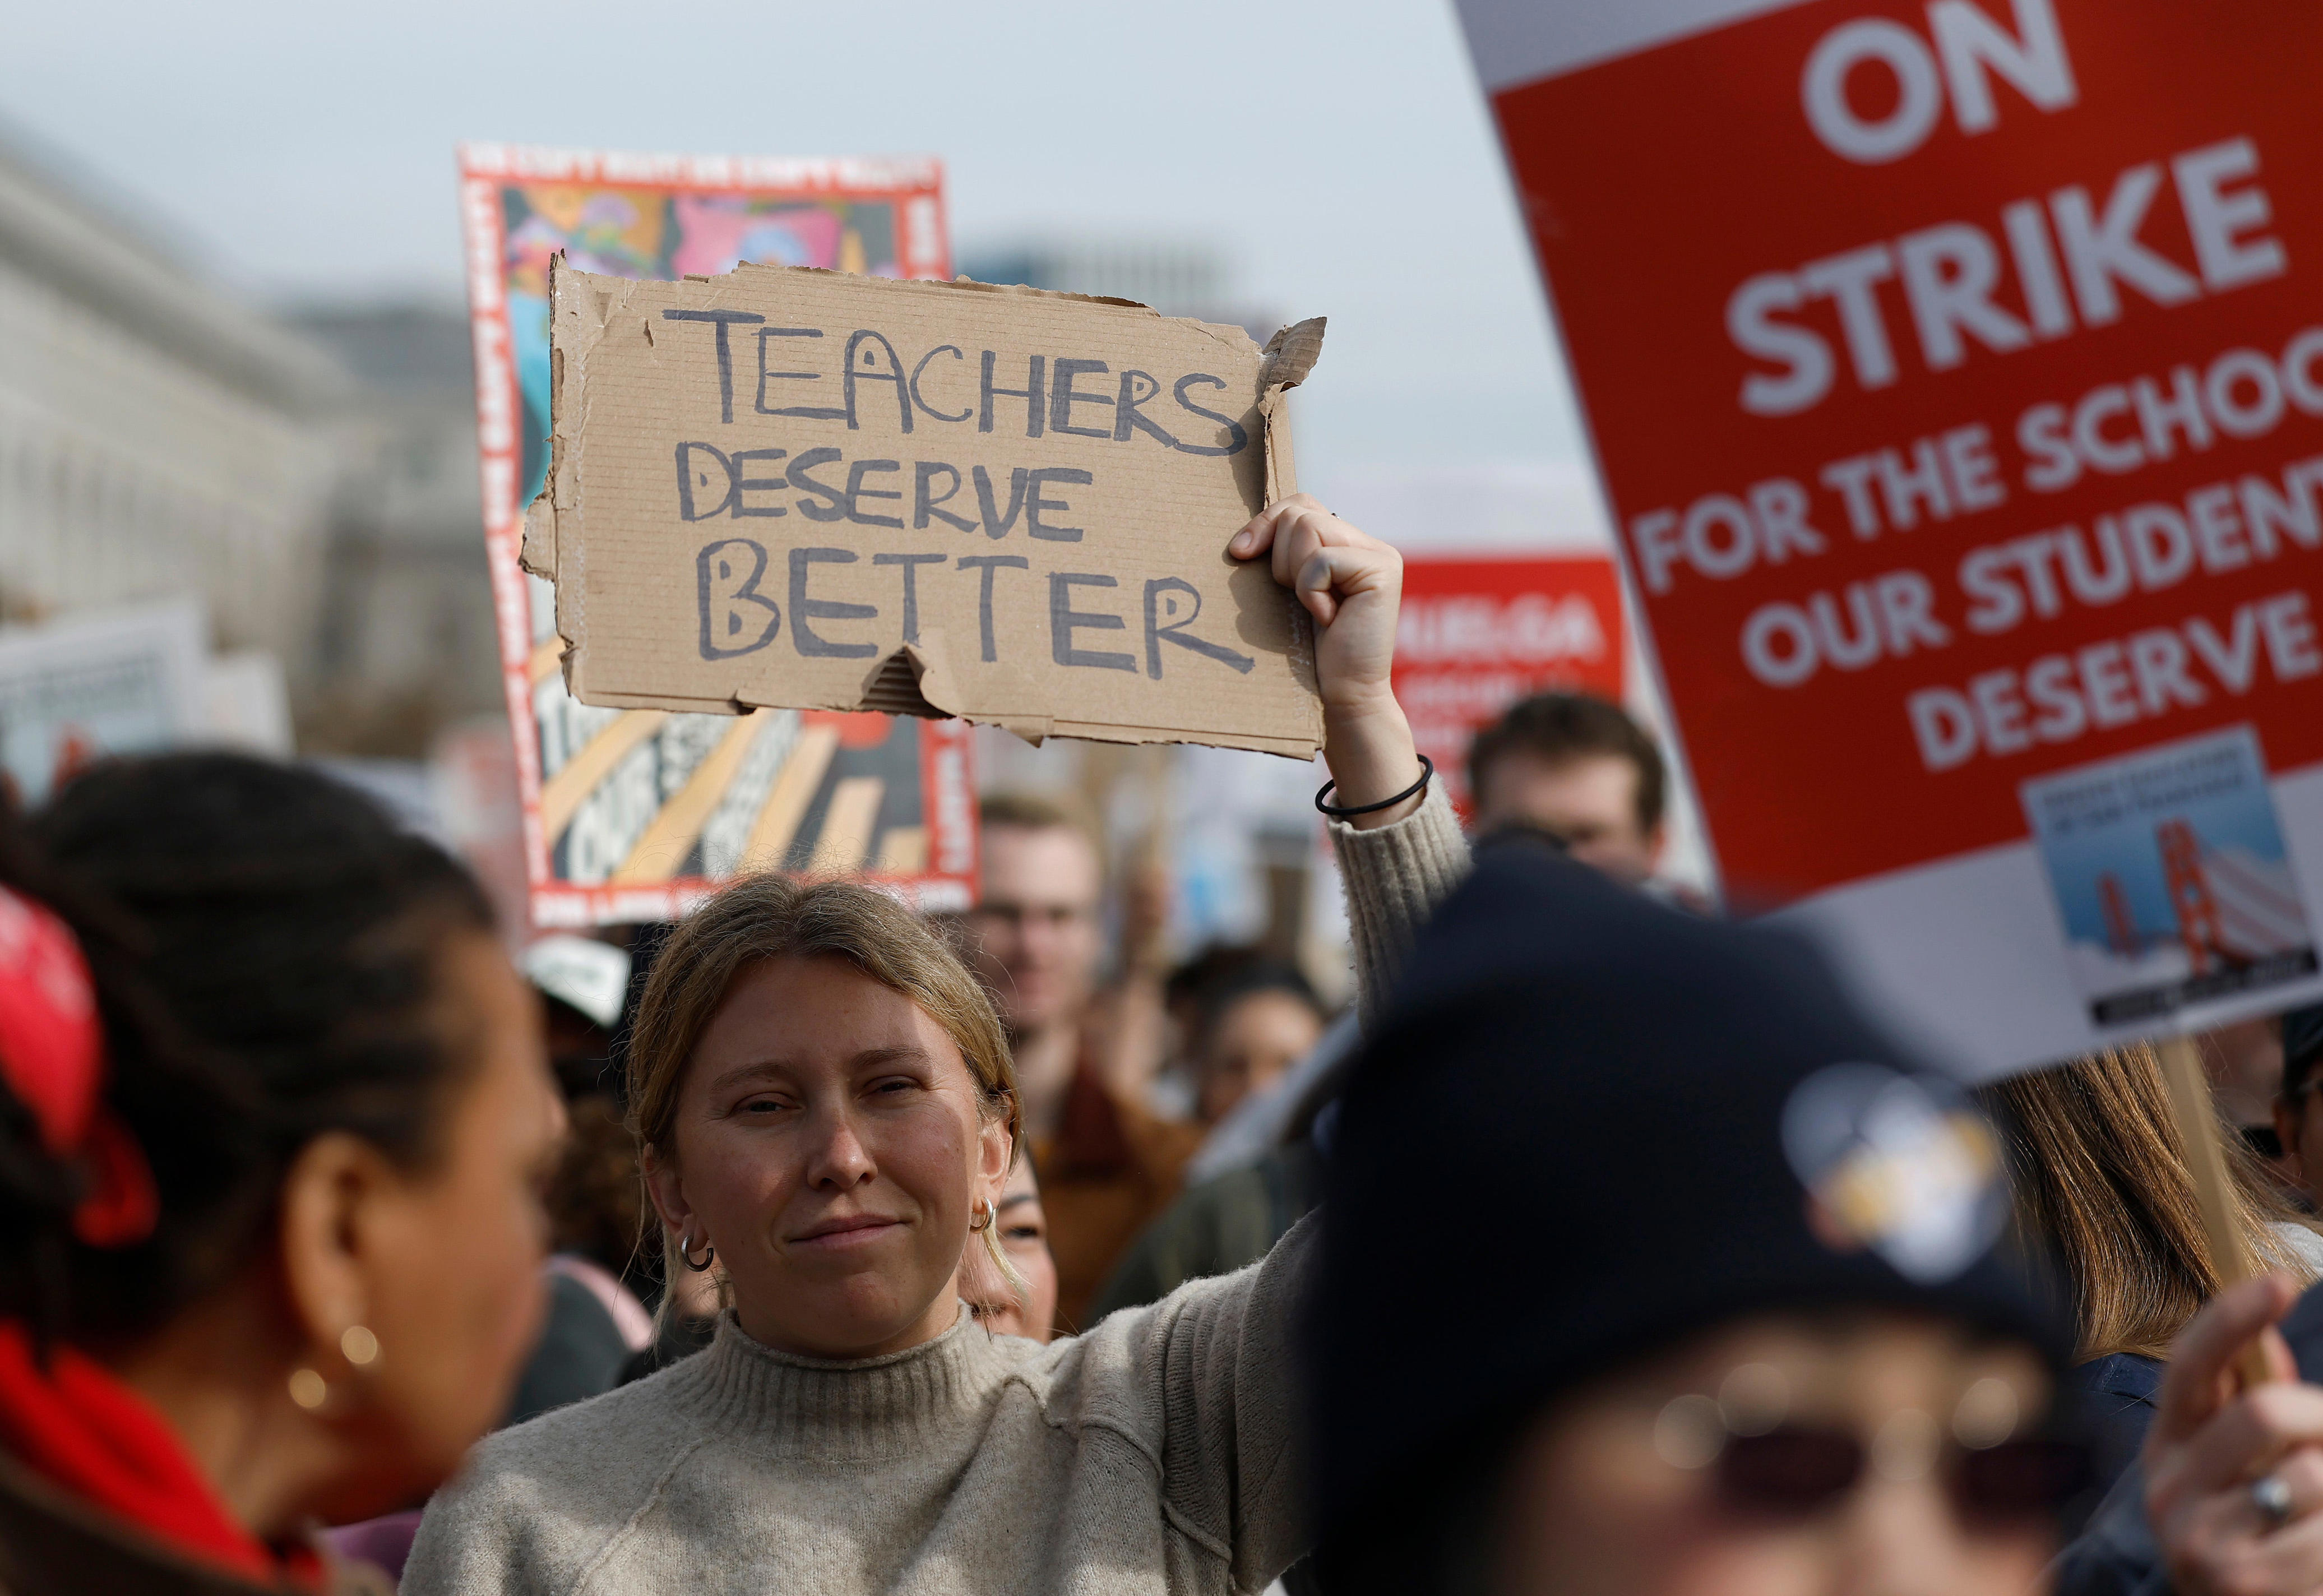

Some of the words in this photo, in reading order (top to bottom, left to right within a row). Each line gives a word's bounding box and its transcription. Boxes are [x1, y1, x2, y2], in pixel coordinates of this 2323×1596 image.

[1800, 0, 2077, 163] ON
[1724, 137, 2286, 416] STRIKE
[661, 308, 1248, 456] TEACHERS
[674, 441, 1093, 542] DESERVE
[1632, 478, 1827, 595] FOR
[1821, 423, 2006, 539] THE
[1741, 570, 1951, 687] OUR
[1959, 454, 2323, 634] STUDEN
[696, 538, 1255, 680] BETTER
[1908, 592, 2322, 772] DESERVE
